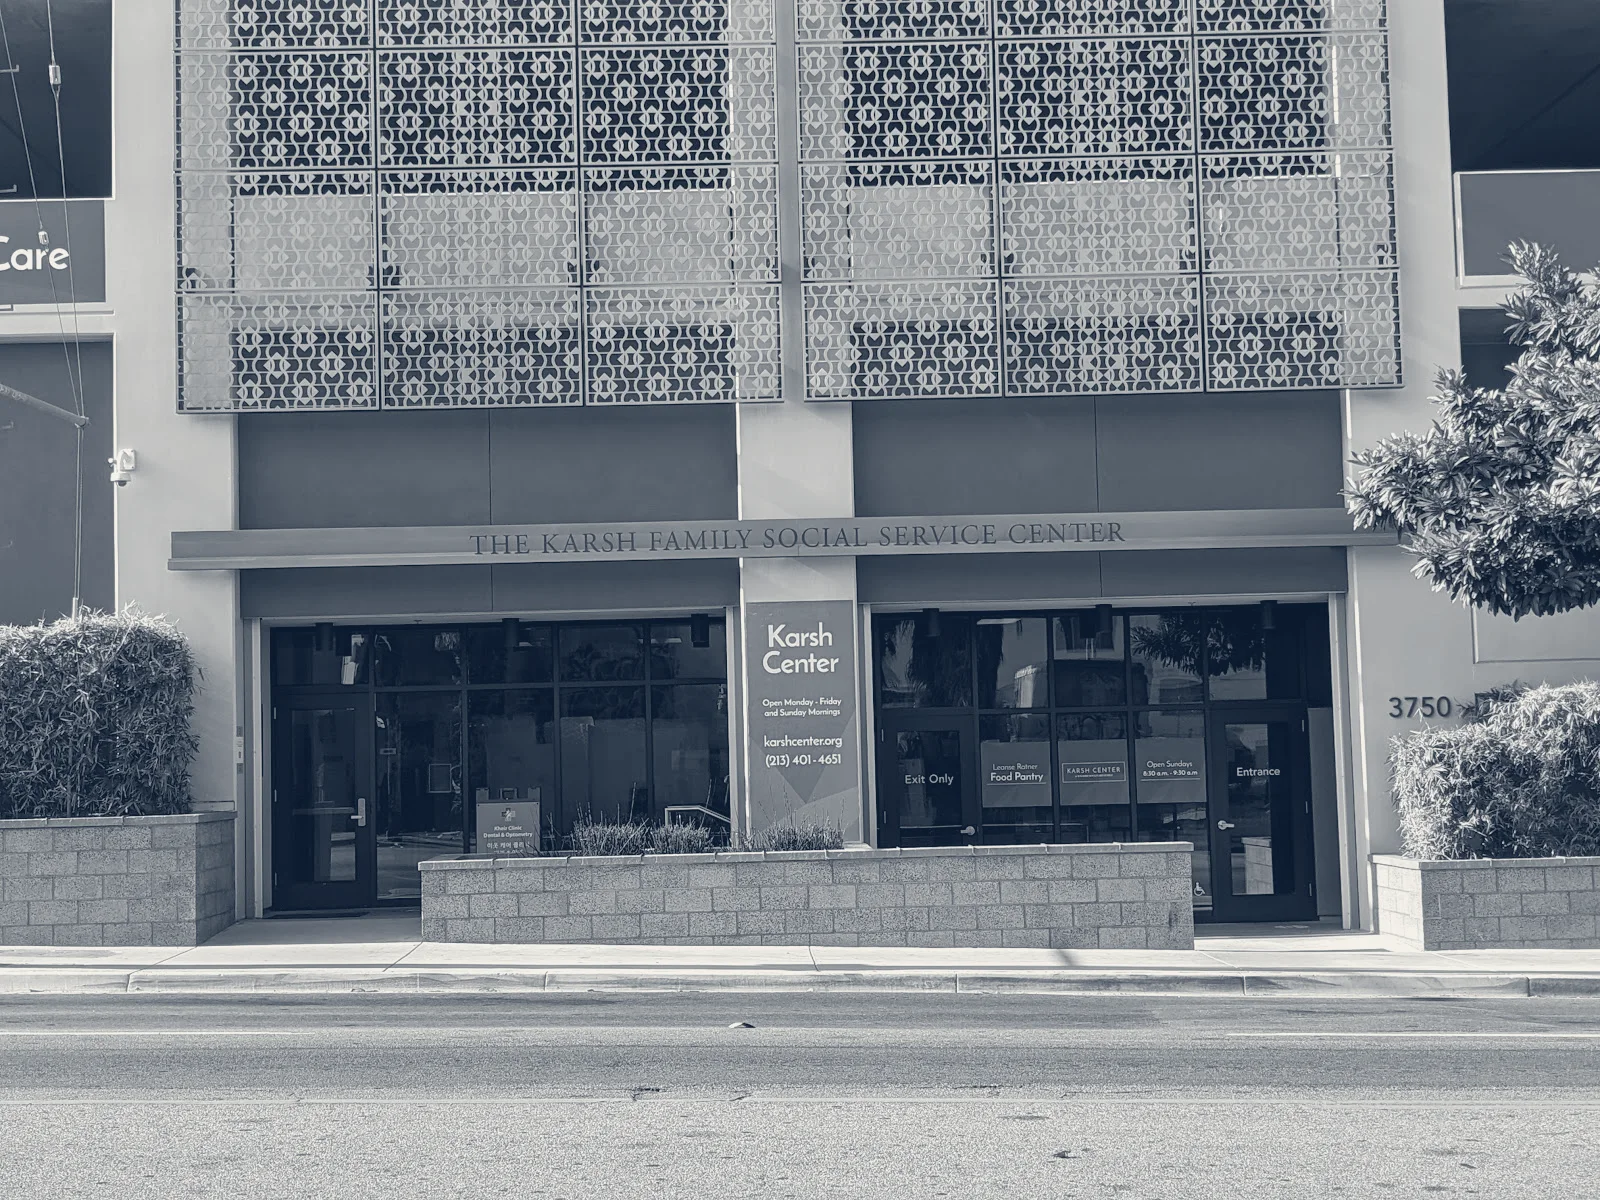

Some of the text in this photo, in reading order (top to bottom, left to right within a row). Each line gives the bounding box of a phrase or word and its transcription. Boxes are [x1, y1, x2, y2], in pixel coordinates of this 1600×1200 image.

[469, 522, 1125, 556] THE KARSH FAMILY SOCIAL SERVICE CENTER
[767, 621, 833, 648] Karsh
[762, 650, 840, 674] Center
[762, 698, 783, 708] Open
[784, 697, 814, 707] Monday
[819, 696, 842, 706] Friday
[1388, 696, 1452, 718] 3750
[764, 707, 841, 717] and Sunday Mornings
[763, 734, 843, 748] karshcenter.org
[765, 753, 790, 768] (213)
[792, 754, 811, 765] 401
[818, 753, 841, 765] 4651
[1016, 762, 1038, 770] Ratner
[1146, 759, 1193, 769] Open Sundays
[1092, 766, 1121, 774] CENTER
[1142, 769, 1157, 777] 8:30
[1172, 769, 1186, 777] 9:30
[1236, 766, 1281, 777] Entrance
[904, 773, 954, 786] Exit Only
[990, 771, 1044, 783] Food Pantry
